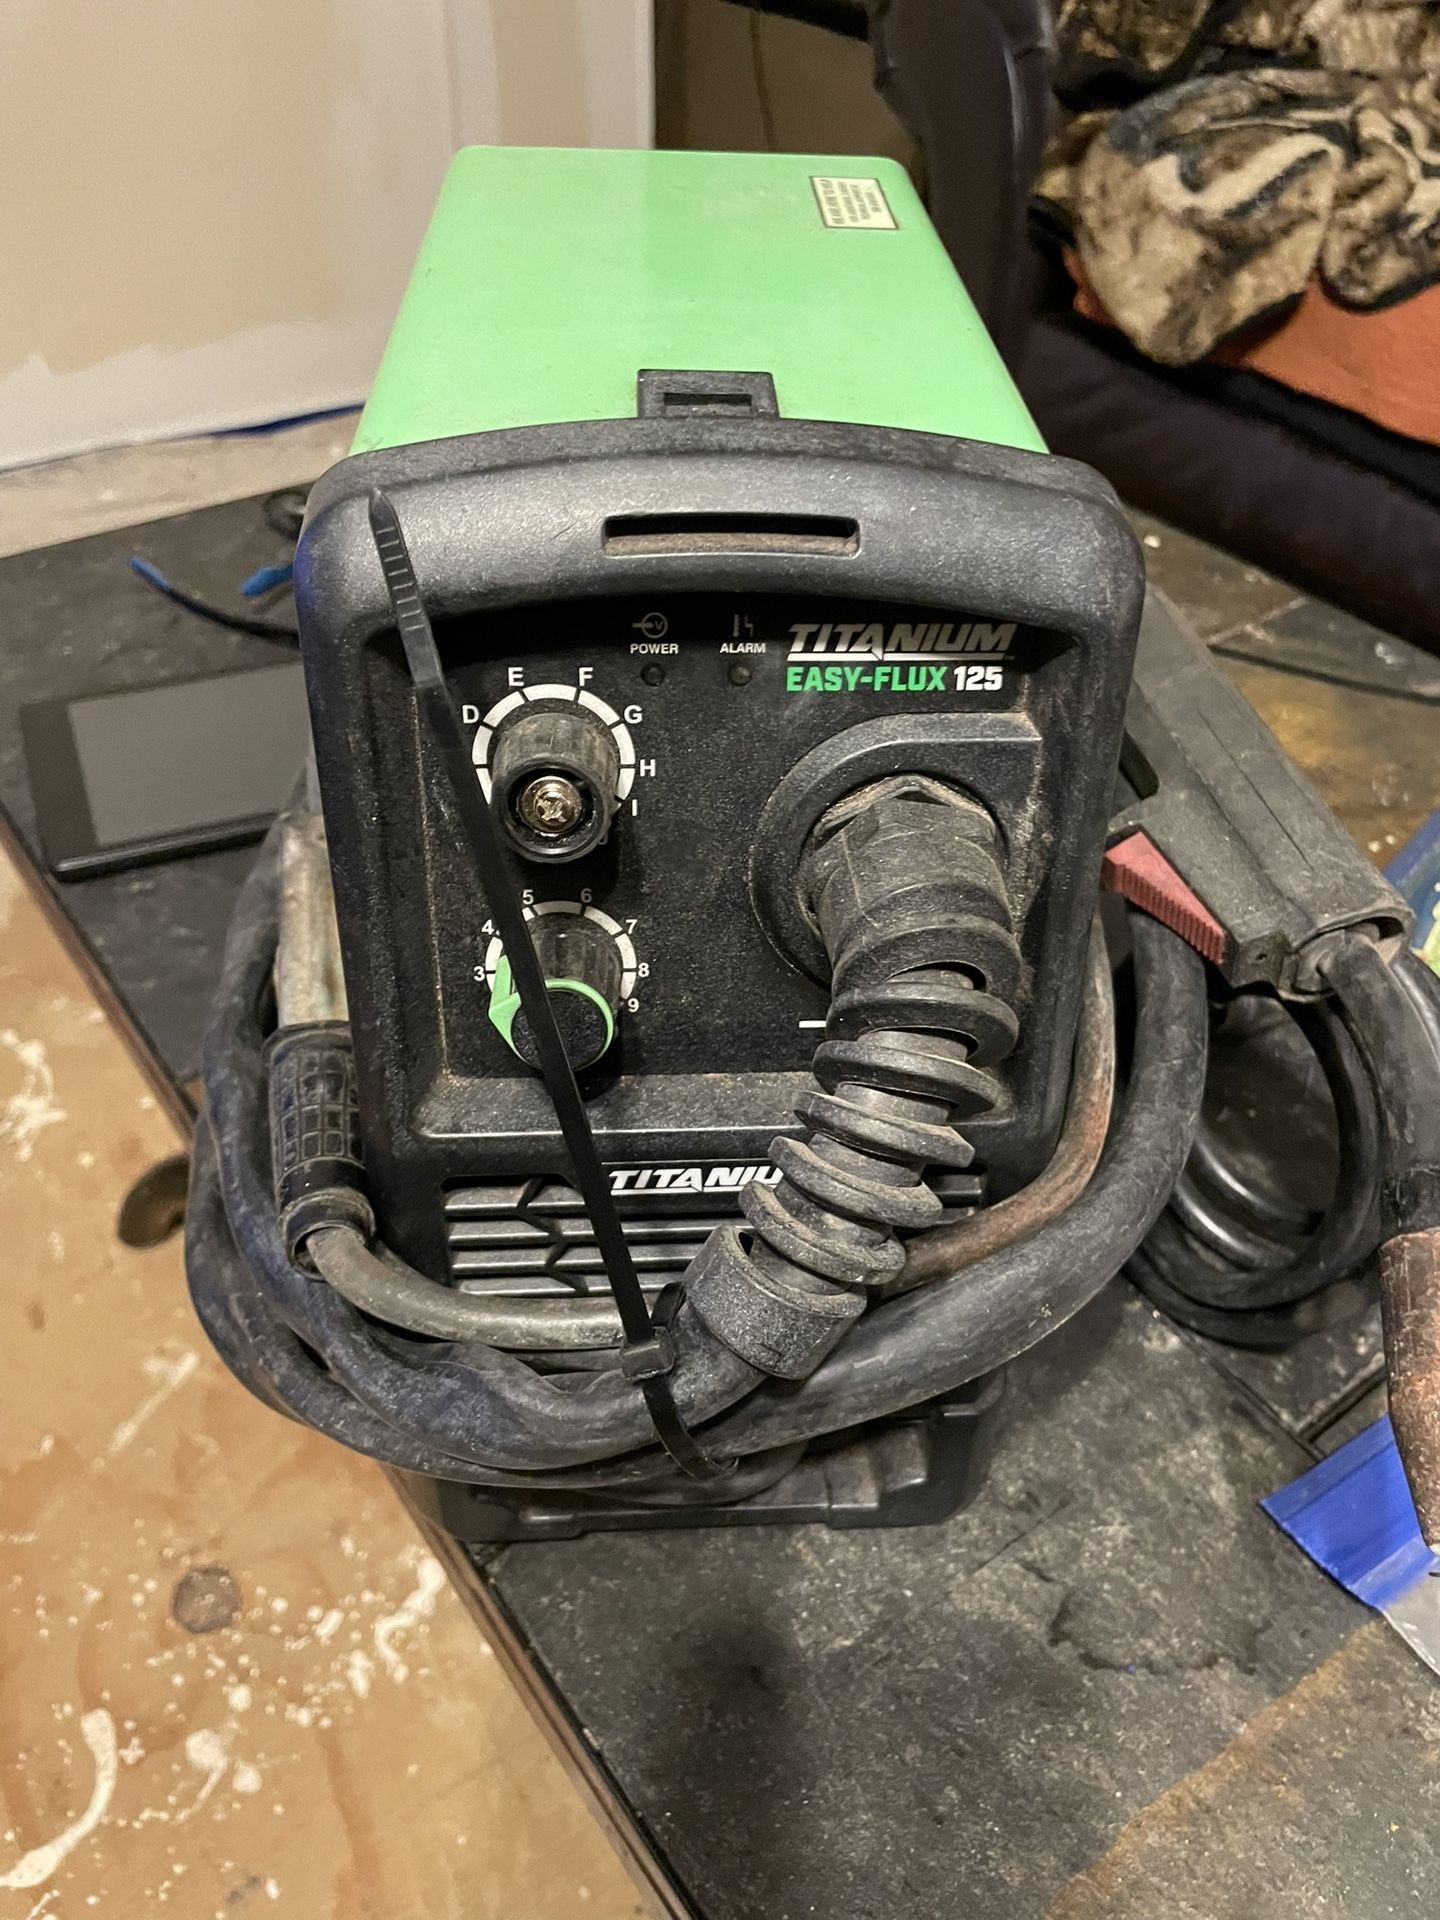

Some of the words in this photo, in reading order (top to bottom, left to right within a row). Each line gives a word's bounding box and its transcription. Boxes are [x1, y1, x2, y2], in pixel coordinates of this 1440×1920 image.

[630, 643, 679, 654] POWER
[720, 642, 766, 654] ALARM
[788, 623, 1018, 660] TITANIUM
[508, 667, 525, 687] E
[578, 667, 594, 687] F
[786, 666, 948, 692] EASY-FLUX
[953, 666, 1004, 692] 125
[462, 705, 480, 724] D
[624, 705, 643, 724] G
[639, 759, 656, 777] H
[631, 799, 638, 817] I
[522, 889, 534, 905] 5
[580, 888, 593, 903] 6
[481, 919, 495, 935] 4
[625, 919, 638, 935] 7
[473, 966, 486, 982] 3
[637, 962, 650, 978] 8
[627, 998, 640, 1013] 9
[608, 1165, 784, 1196] TITANIU
